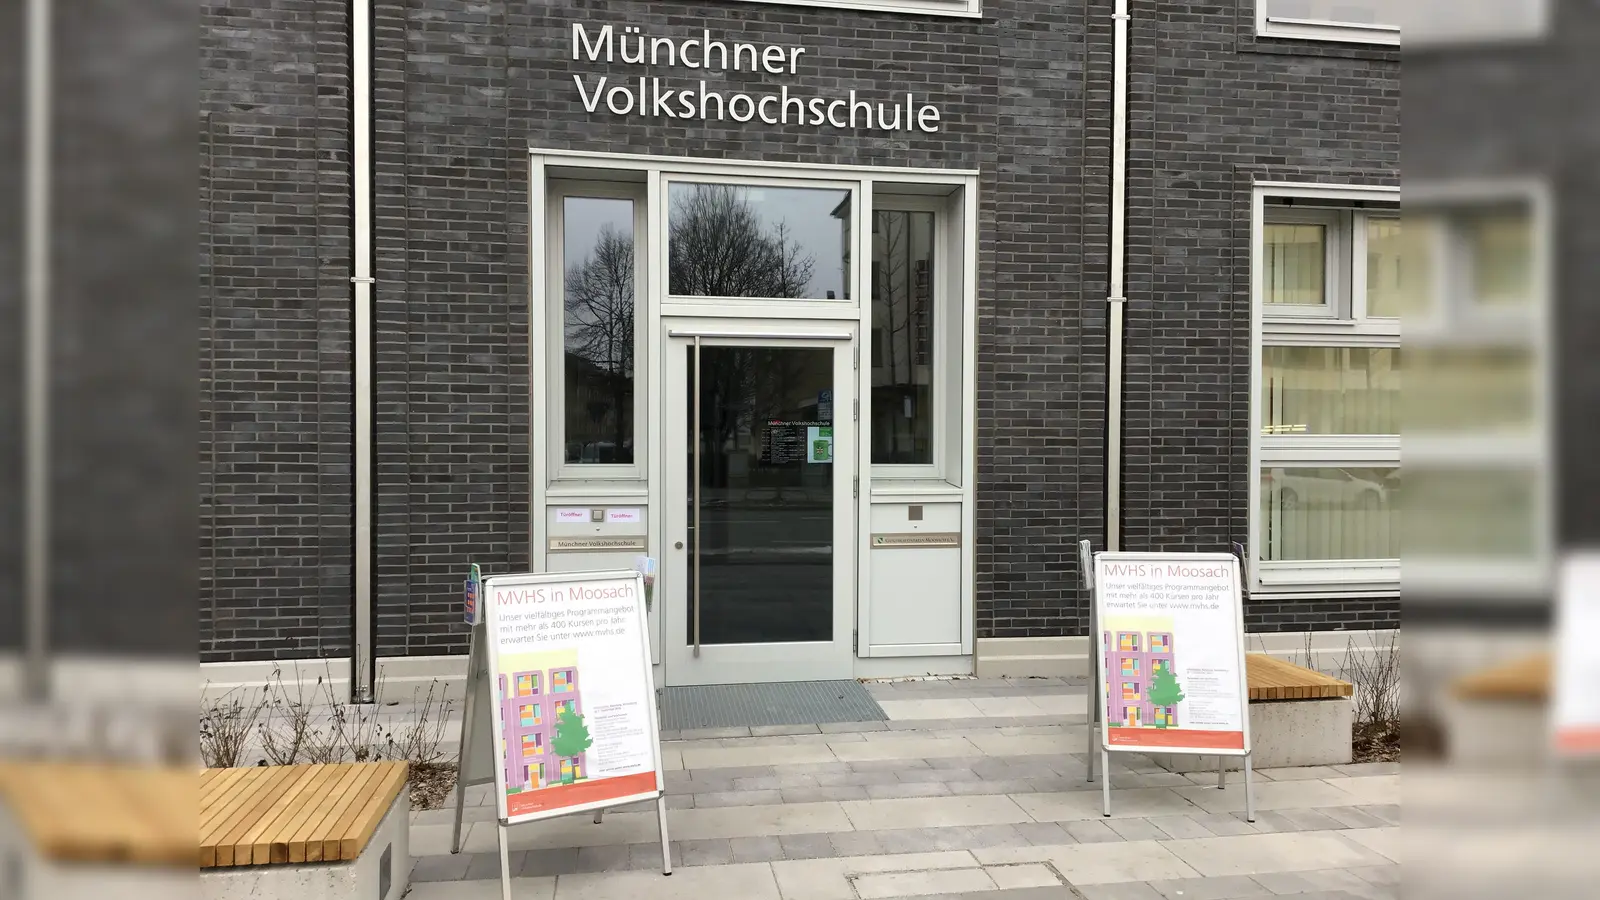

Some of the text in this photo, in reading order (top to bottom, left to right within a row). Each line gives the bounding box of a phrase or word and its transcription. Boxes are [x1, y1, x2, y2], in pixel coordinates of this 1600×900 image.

[572, 22, 806, 75] Münchner
[573, 75, 941, 133] Volkshochschule
[1104, 564, 1229, 578] MVHS in Moosach
[497, 588, 546, 606] MVHS
[551, 587, 564, 603] in
[569, 583, 634, 601] Moosach
[1127, 583, 1163, 592] vielfältiges
[1165, 583, 1230, 593] Programmangebot
[1139, 592, 1149, 600] als
[1150, 592, 1164, 600] 400
[1191, 594, 1203, 602] pro
[1205, 593, 1219, 601] Jahr
[499, 605, 635, 622] Unser vielfältiges Programmangebot
[1169, 602, 1220, 610] www.mvhs.de
[500, 615, 626, 633] mit mehr als 400 Kursen pro Jahr
[500, 627, 626, 644] erwartet Sie unter www.mvhs.de
